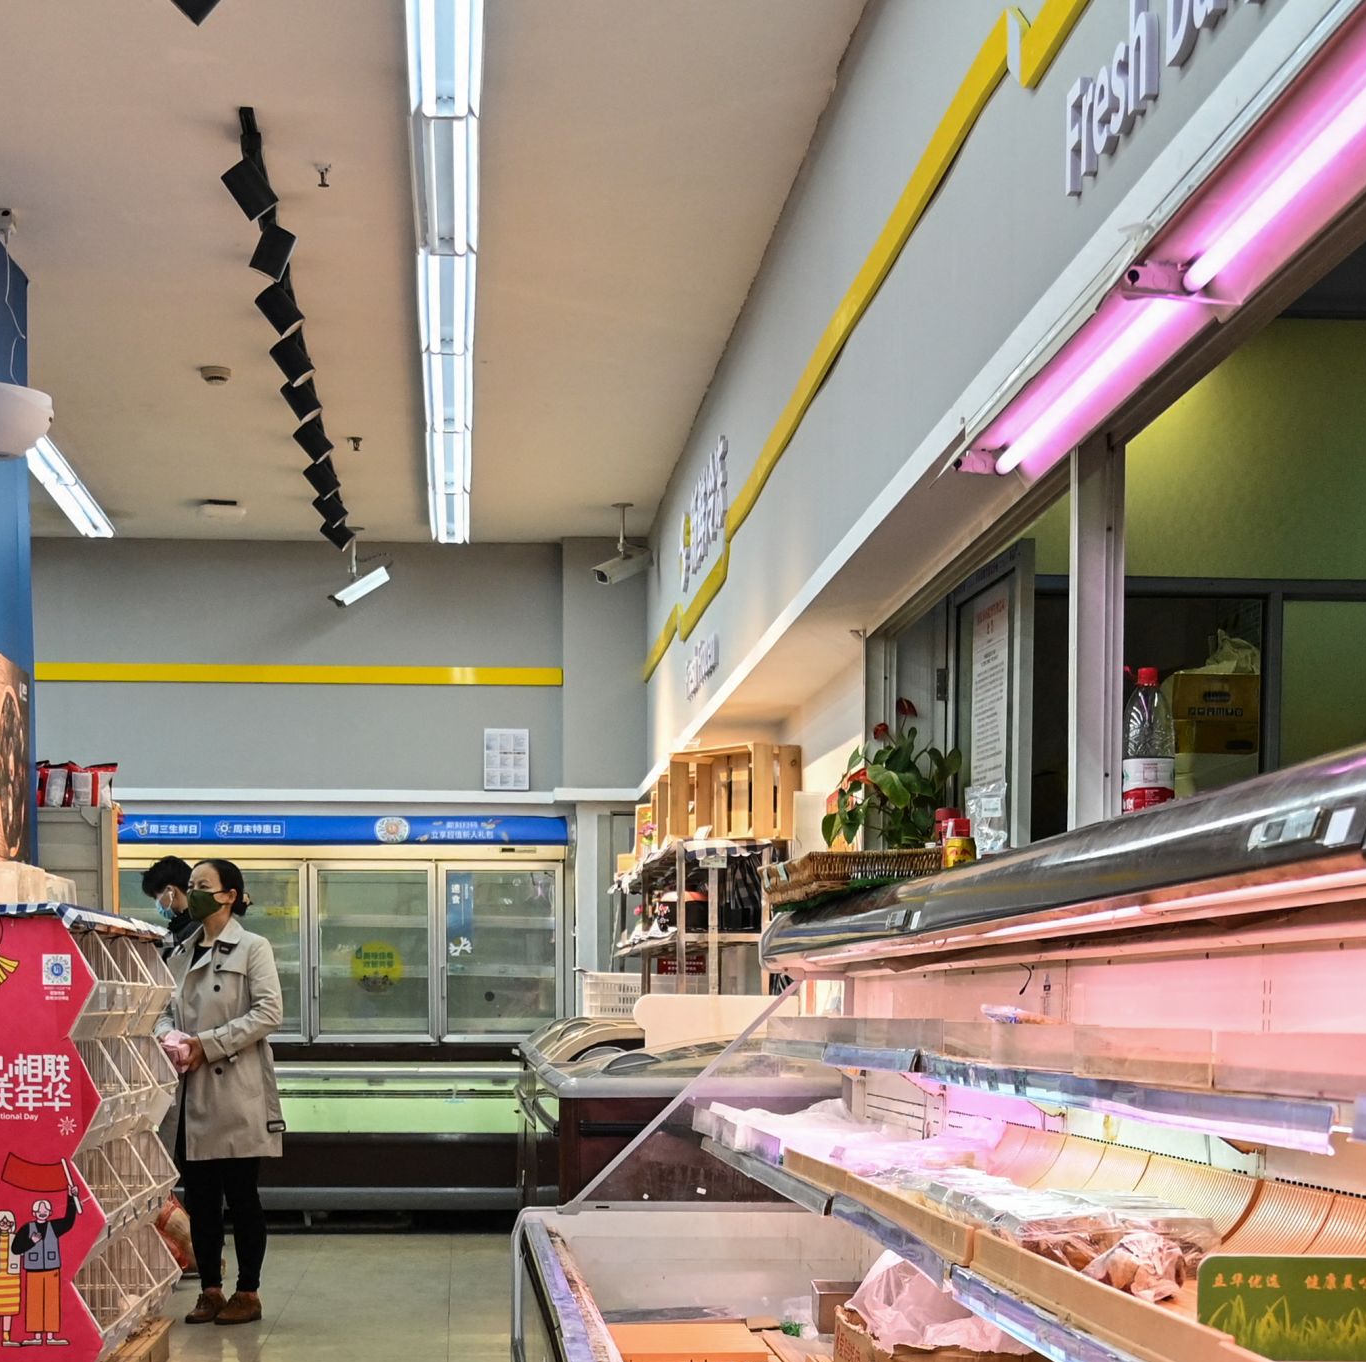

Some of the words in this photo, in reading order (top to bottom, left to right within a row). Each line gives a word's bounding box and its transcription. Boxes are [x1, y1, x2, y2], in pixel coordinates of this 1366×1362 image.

[1066, 0, 1159, 196] Fresh
[23, 1112, 39, 1122] Day
[1212, 1272, 1282, 1289] 立华优选
